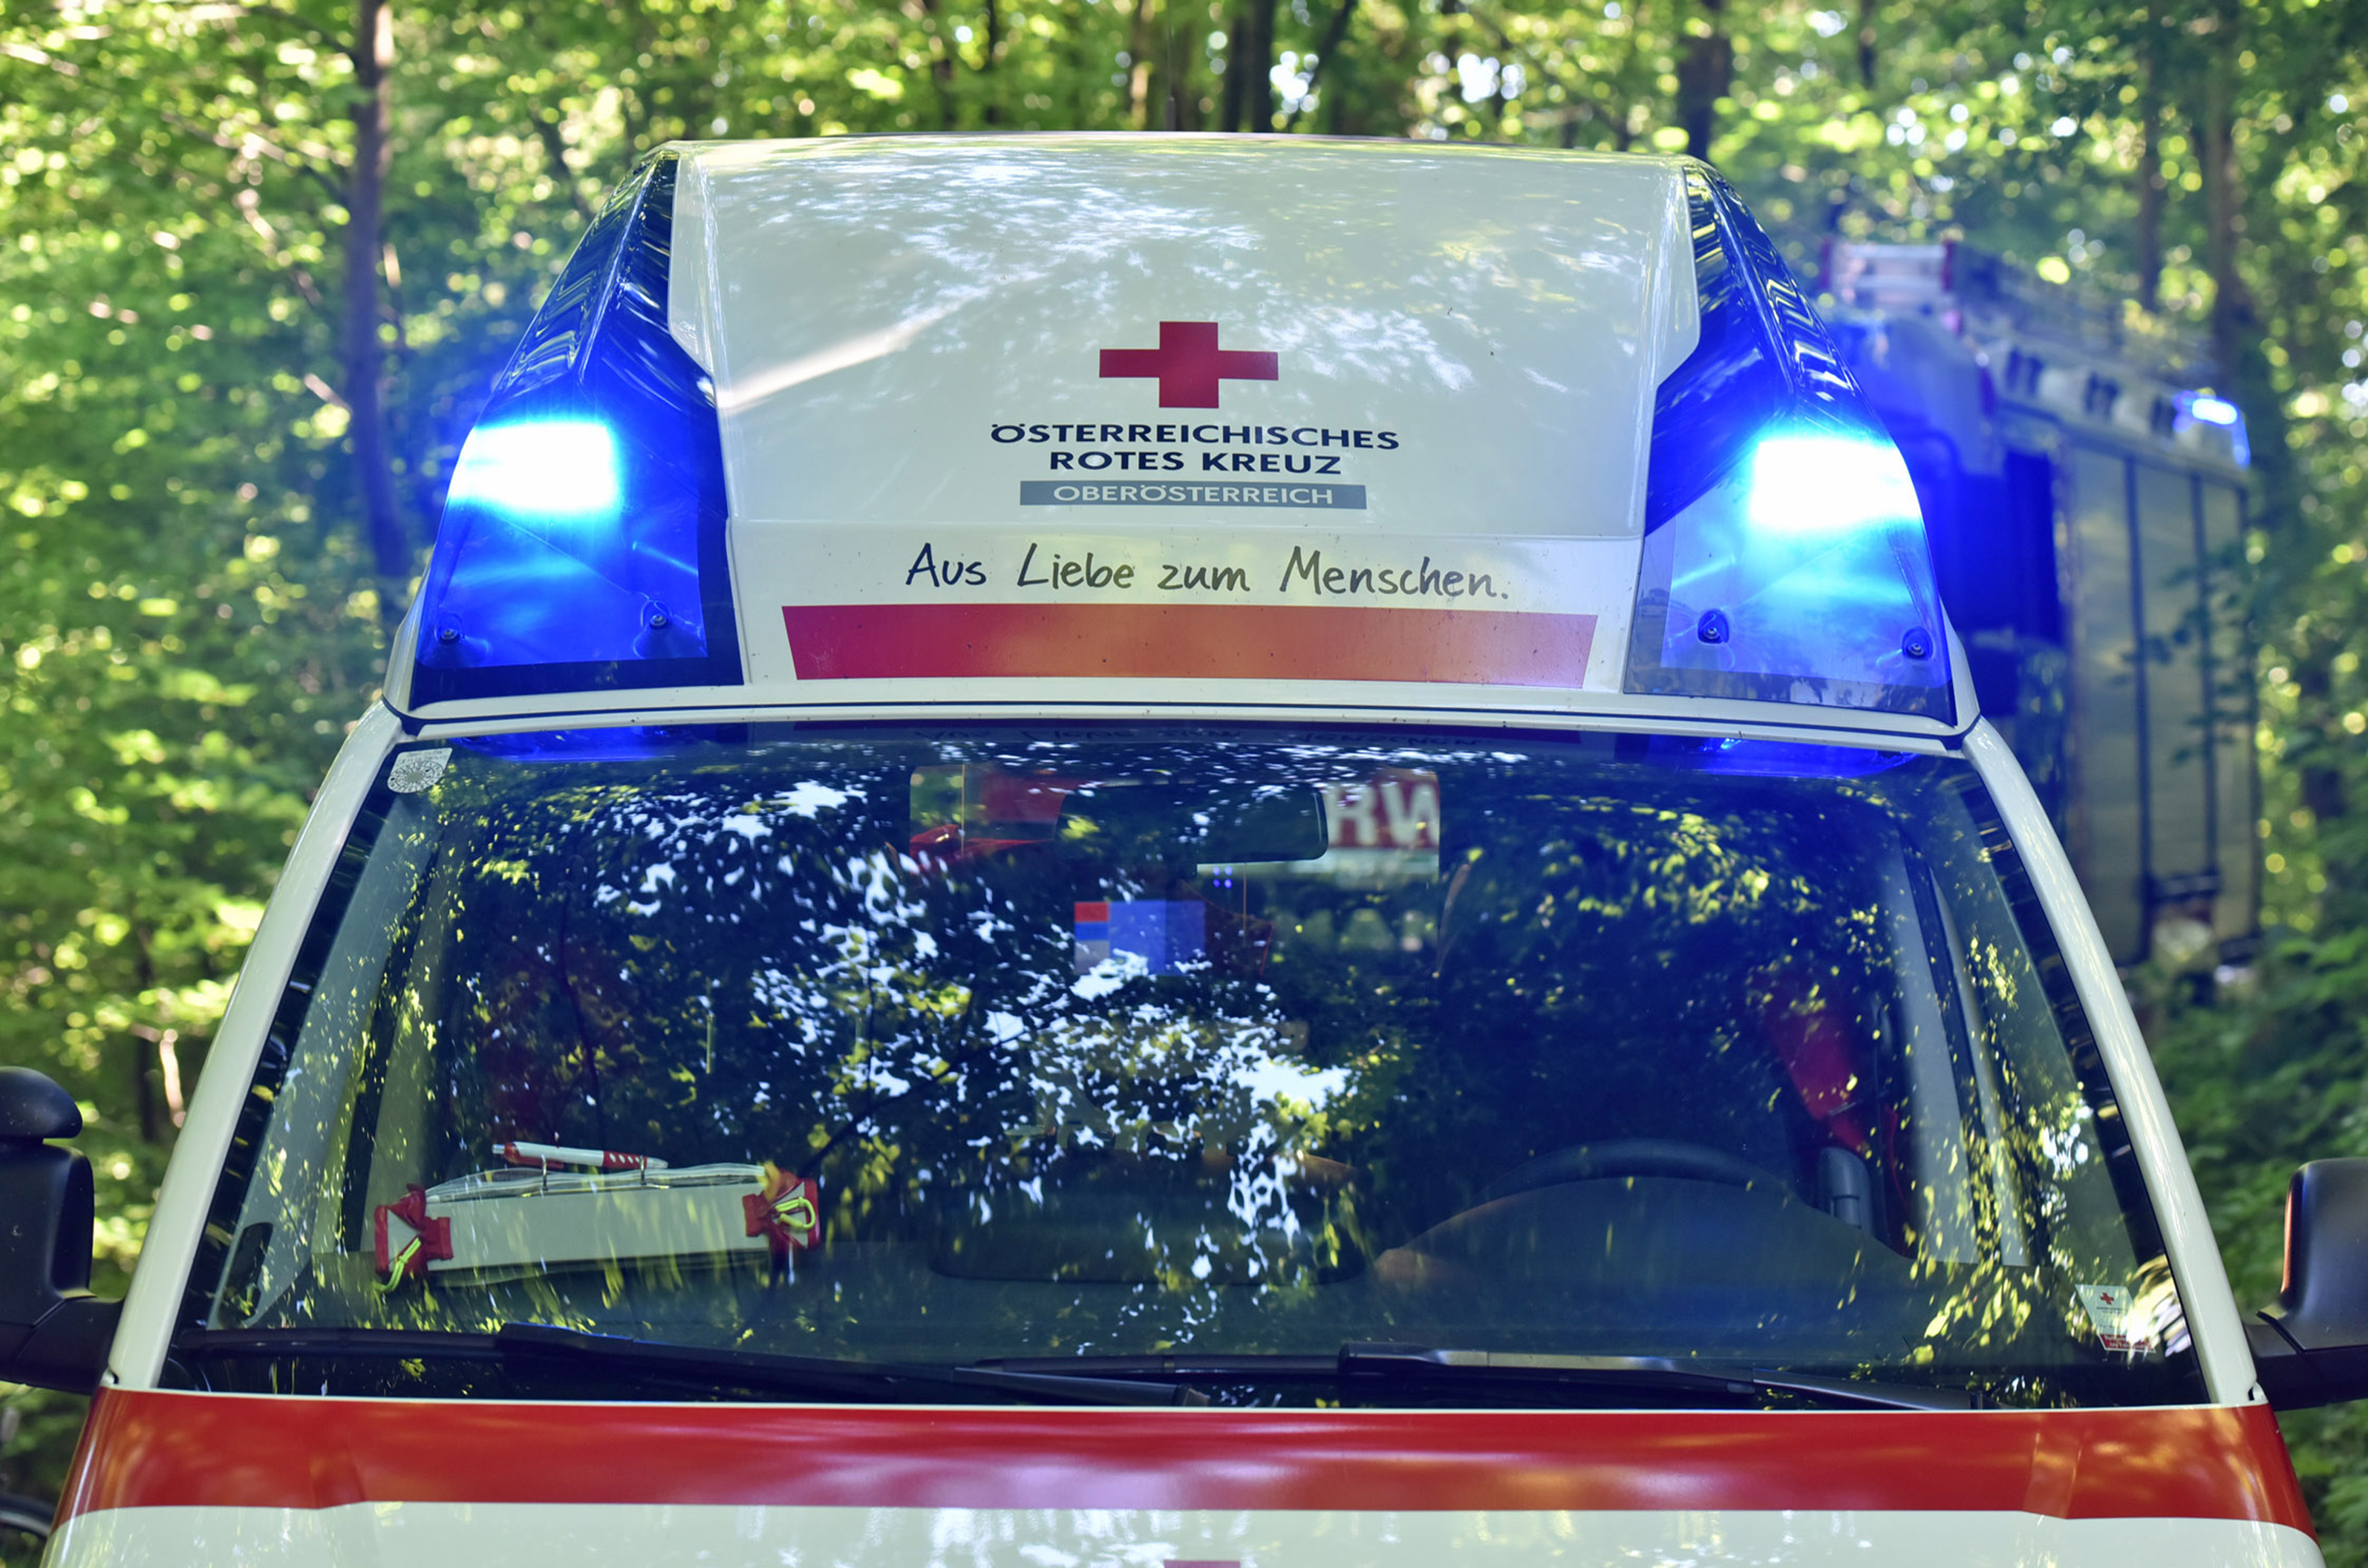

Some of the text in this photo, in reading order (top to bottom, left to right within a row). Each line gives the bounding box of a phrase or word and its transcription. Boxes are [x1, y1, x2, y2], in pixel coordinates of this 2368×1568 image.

[991, 423, 1400, 450] ÖSTERREICHISCHES
[1050, 451, 1341, 474] ROTES KREUZ
[1053, 485, 1333, 505] OBERÖSTERREICH
[905, 543, 1509, 599] Aus Liebe zum Menschen.
